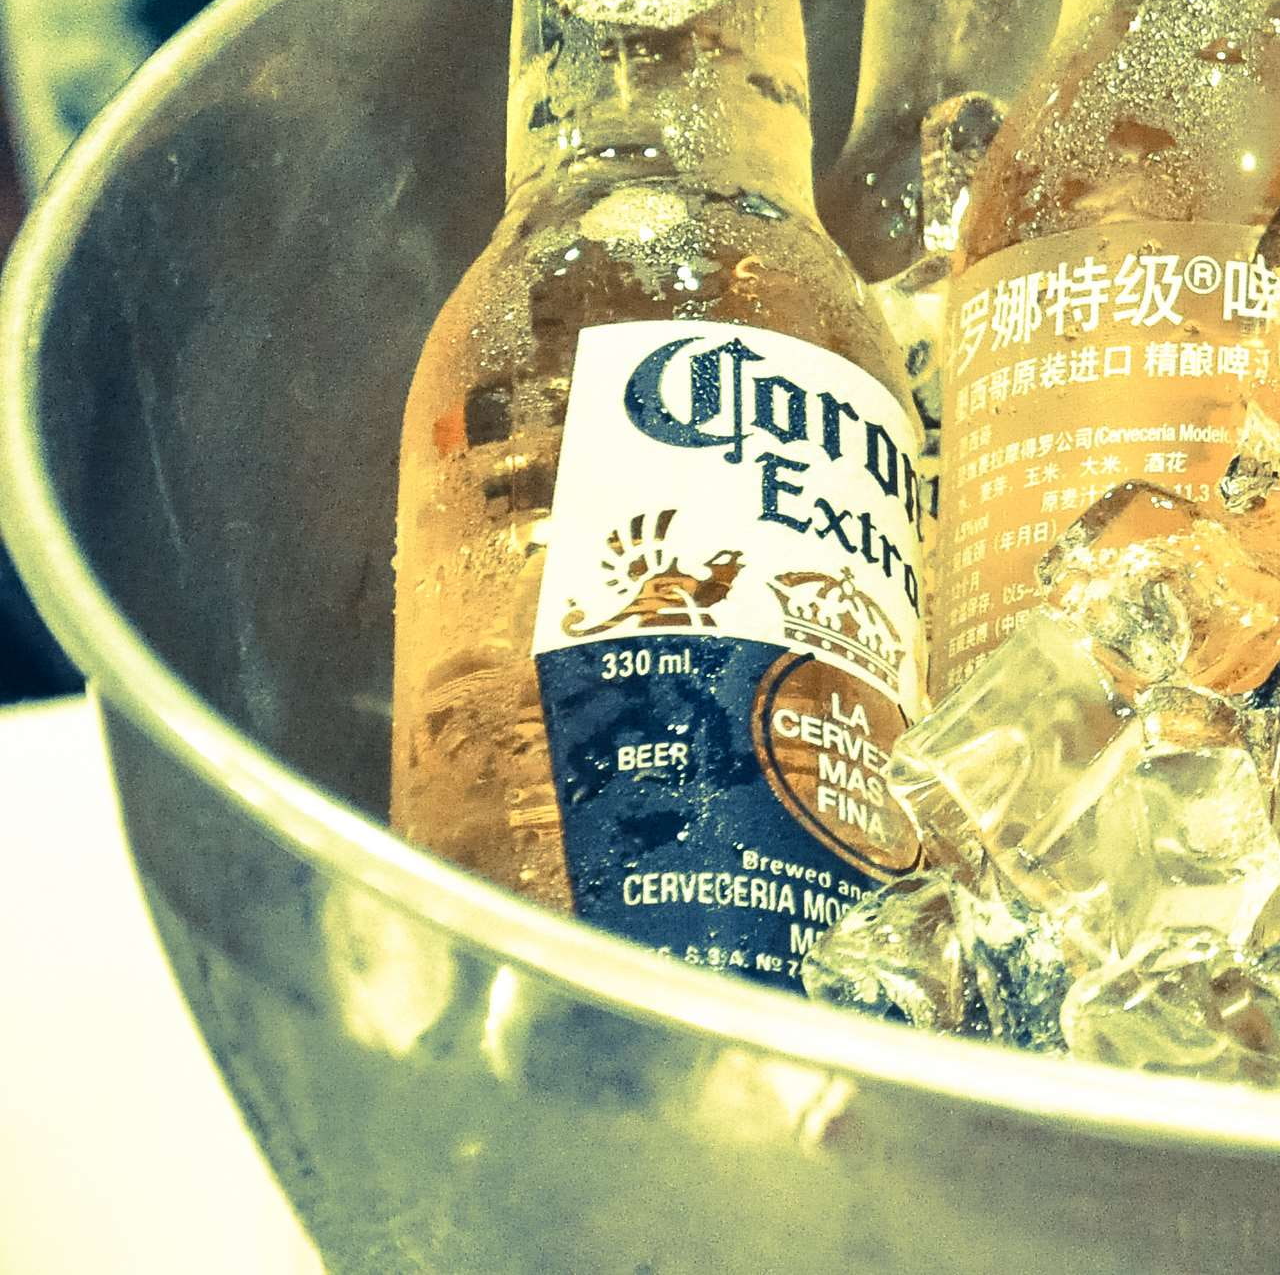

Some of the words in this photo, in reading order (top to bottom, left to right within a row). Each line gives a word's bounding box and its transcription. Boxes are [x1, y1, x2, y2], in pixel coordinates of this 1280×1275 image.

[601, 650, 652, 681] 330
[831, 692, 871, 737] LA
[617, 742, 689, 772] BEER
[818, 752, 885, 808] MAS
[818, 785, 887, 844] FINA
[742, 849, 832, 889] Brewed
